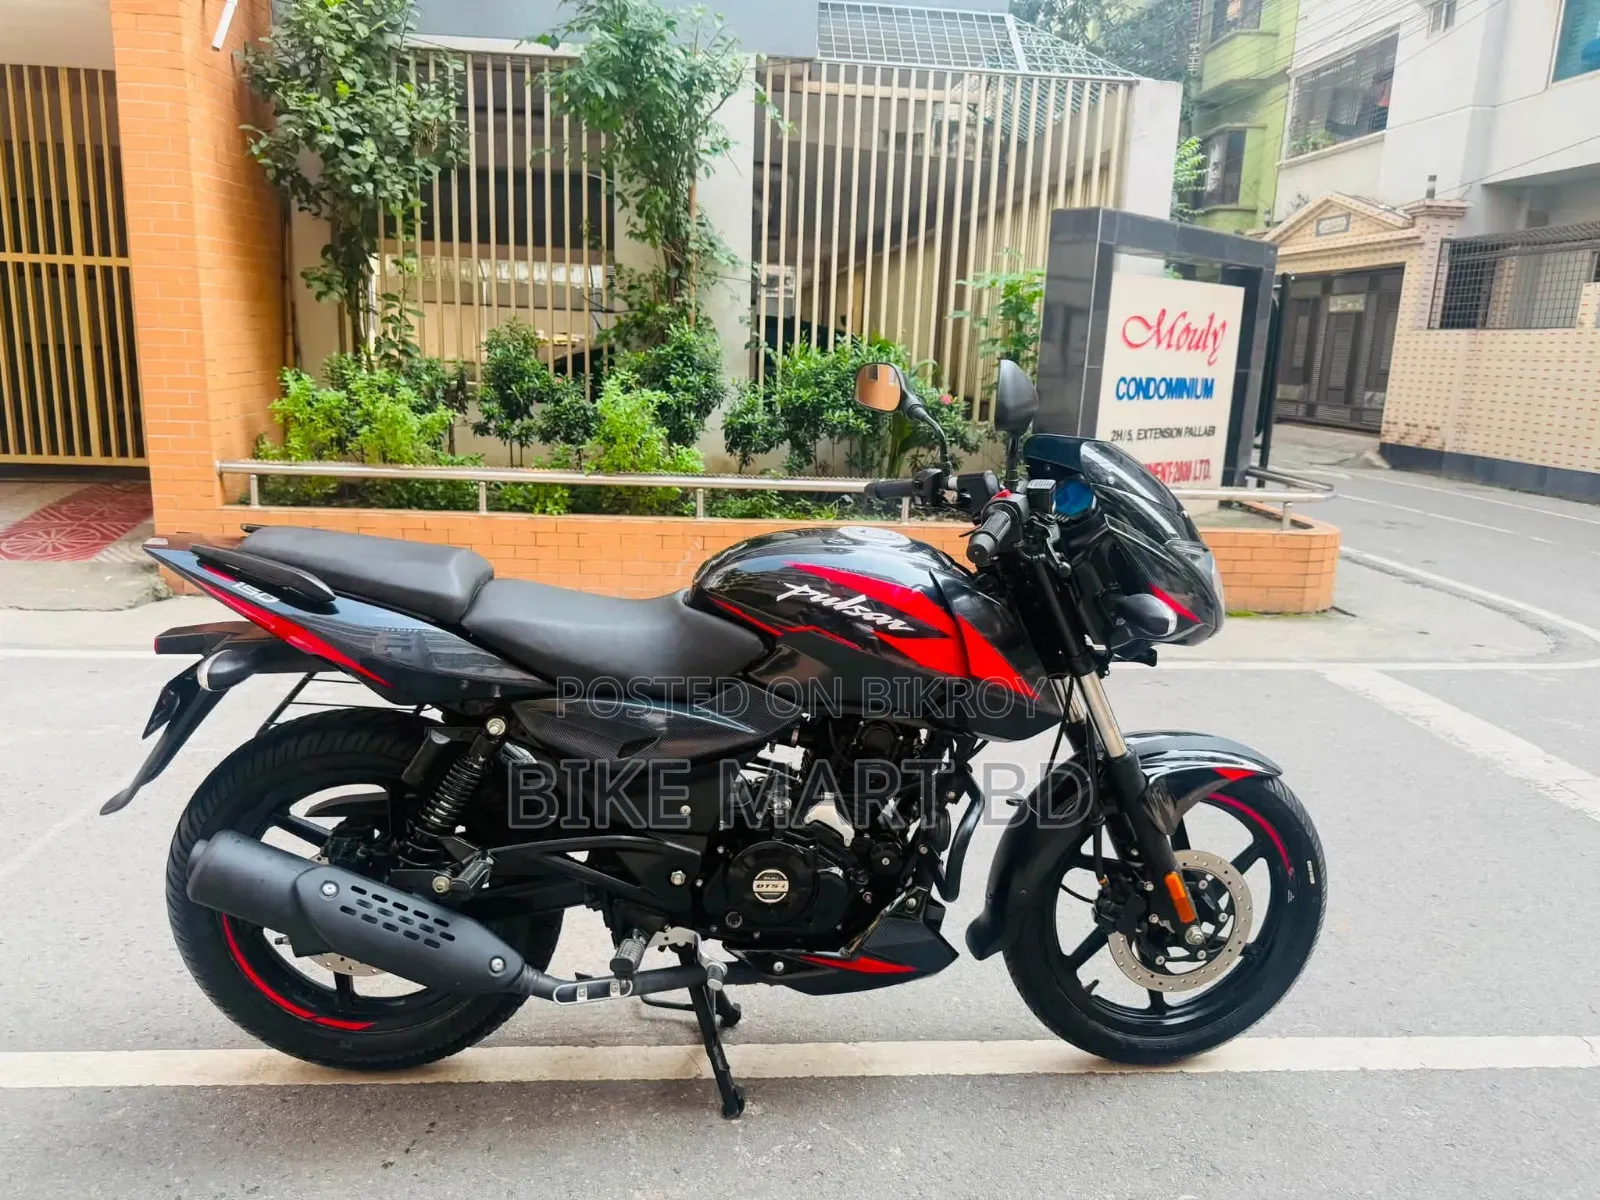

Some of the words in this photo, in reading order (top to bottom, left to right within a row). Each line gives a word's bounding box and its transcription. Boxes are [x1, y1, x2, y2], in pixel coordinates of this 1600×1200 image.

[1123, 308, 1227, 366] Mouly
[1116, 376, 1215, 400] CONDOMINIUM
[1136, 426, 1183, 441] EXTENSION
[1184, 425, 1216, 438] PALLABI
[232, 581, 280, 603] 150
